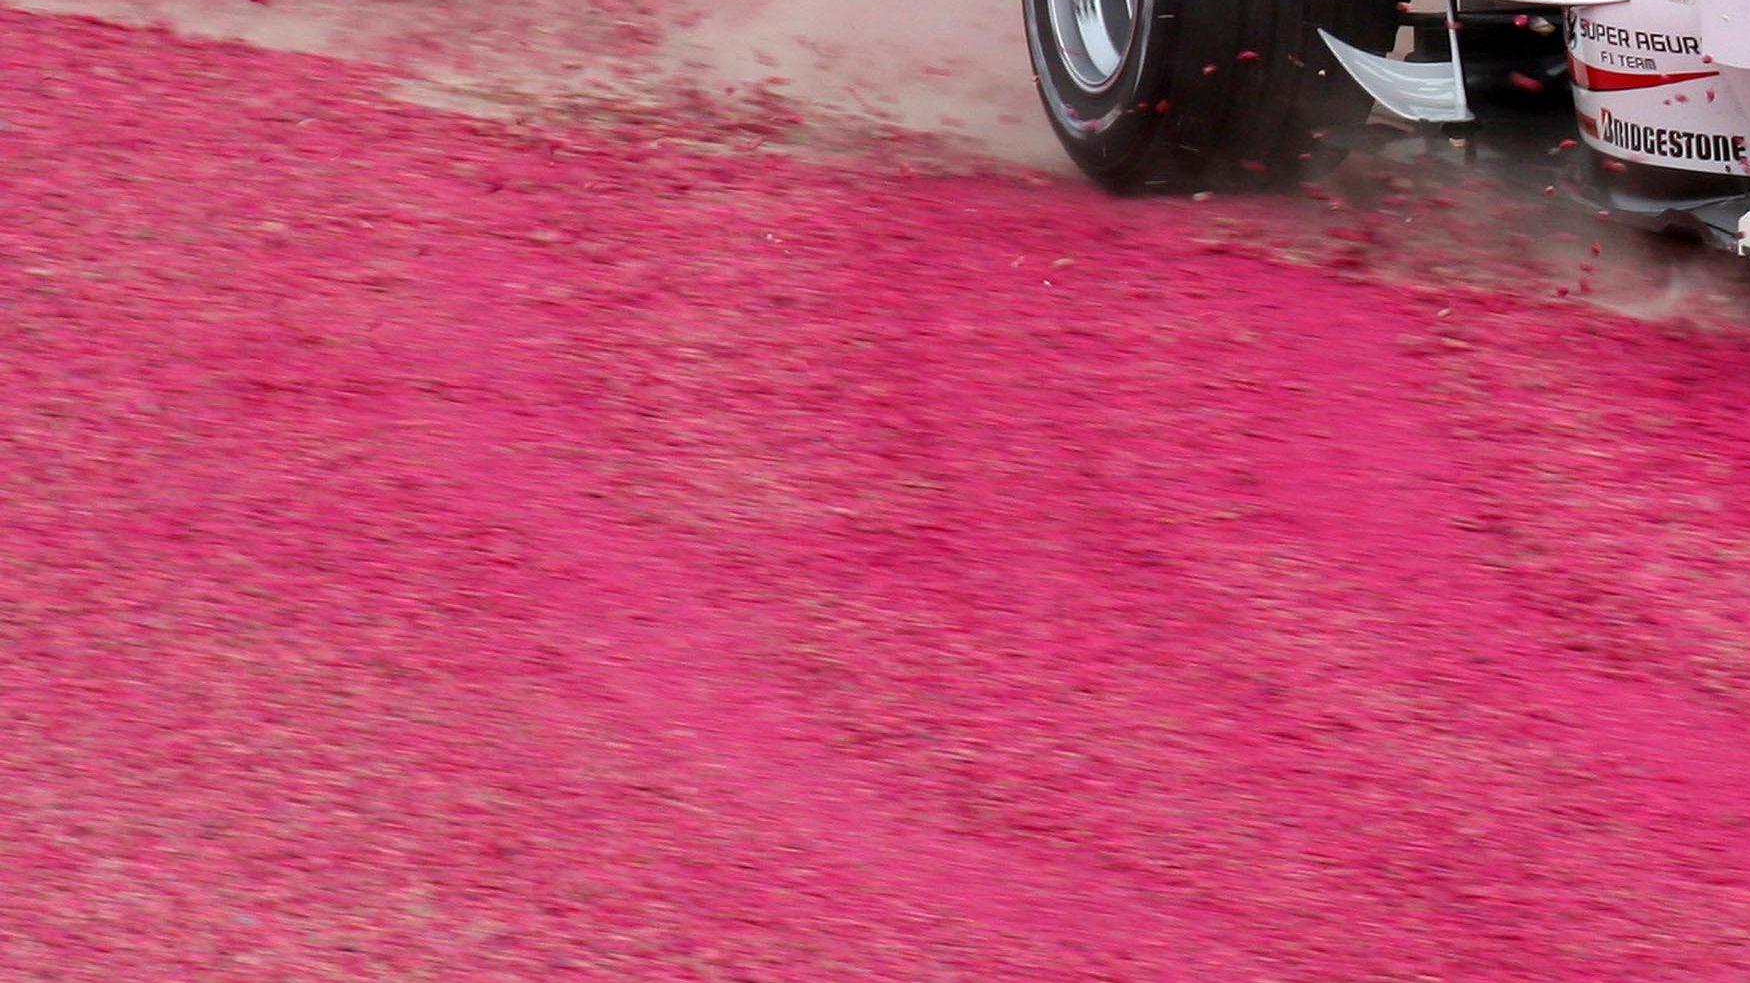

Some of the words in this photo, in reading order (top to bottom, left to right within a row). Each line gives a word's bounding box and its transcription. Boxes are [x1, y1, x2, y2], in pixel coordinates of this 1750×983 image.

[1580, 18, 1631, 49] SUPER
[1635, 30, 1703, 56] AGUR
[1601, 51, 1615, 65] F1
[1618, 54, 1657, 71] TEAM
[1600, 106, 1749, 162] BRIDGESTONE
